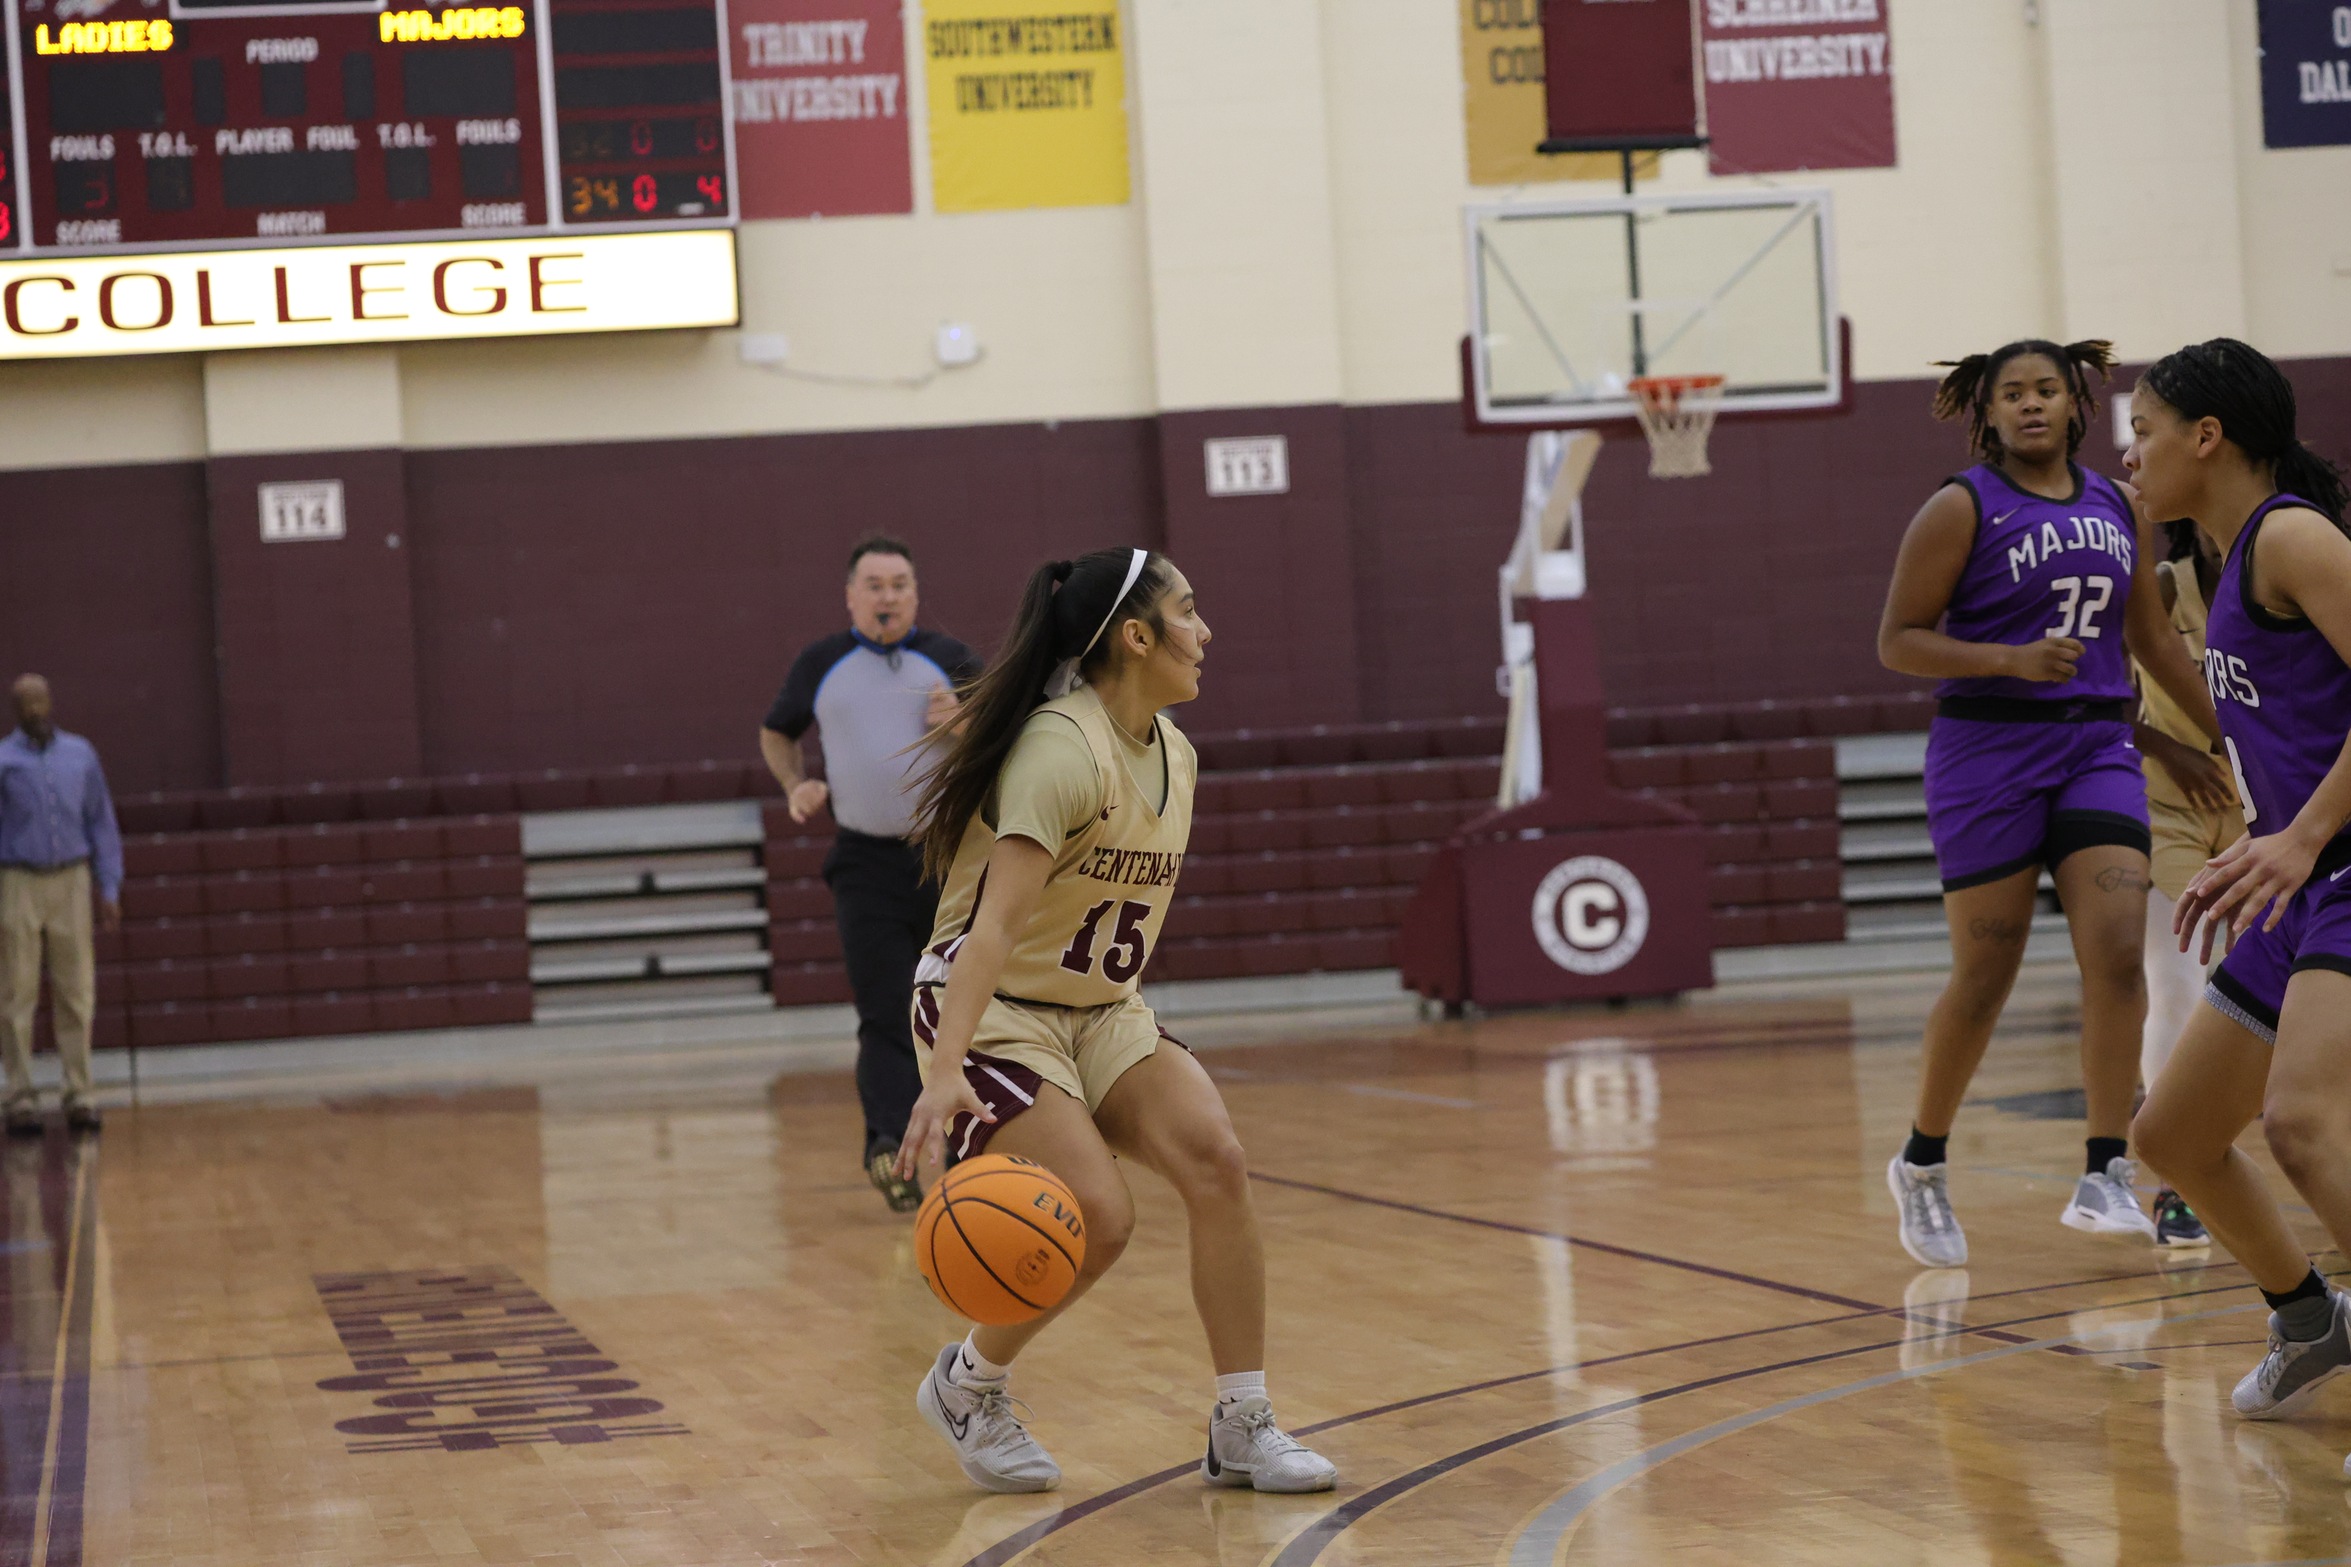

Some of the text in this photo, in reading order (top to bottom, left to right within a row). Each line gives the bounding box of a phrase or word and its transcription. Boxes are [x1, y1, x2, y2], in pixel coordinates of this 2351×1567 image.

[36, 20, 173, 54] LADIES
[379, 7, 525, 42] MAJORS
[246, 37, 319, 64] PERIOD
[741, 19, 868, 67] TRINITY
[1704, 33, 1887, 83] UNIVERSITY
[956, 69, 1094, 113] UNIVERSITY
[51, 134, 115, 161] FOULS
[215, 124, 358, 155] PLAYER FOUL
[455, 118, 521, 145] FOULS
[571, 174, 722, 215] 34 0 4
[56, 218, 121, 244] SCORE
[461, 202, 526, 228] SCORE
[2, 252, 588, 337] COLLEGE
[1222, 459, 1275, 485] 113
[275, 501, 330, 531] 114
[2008, 517, 2132, 583] MAJORS
[2045, 575, 2113, 639] 32
[1059, 899, 1152, 984] 15
